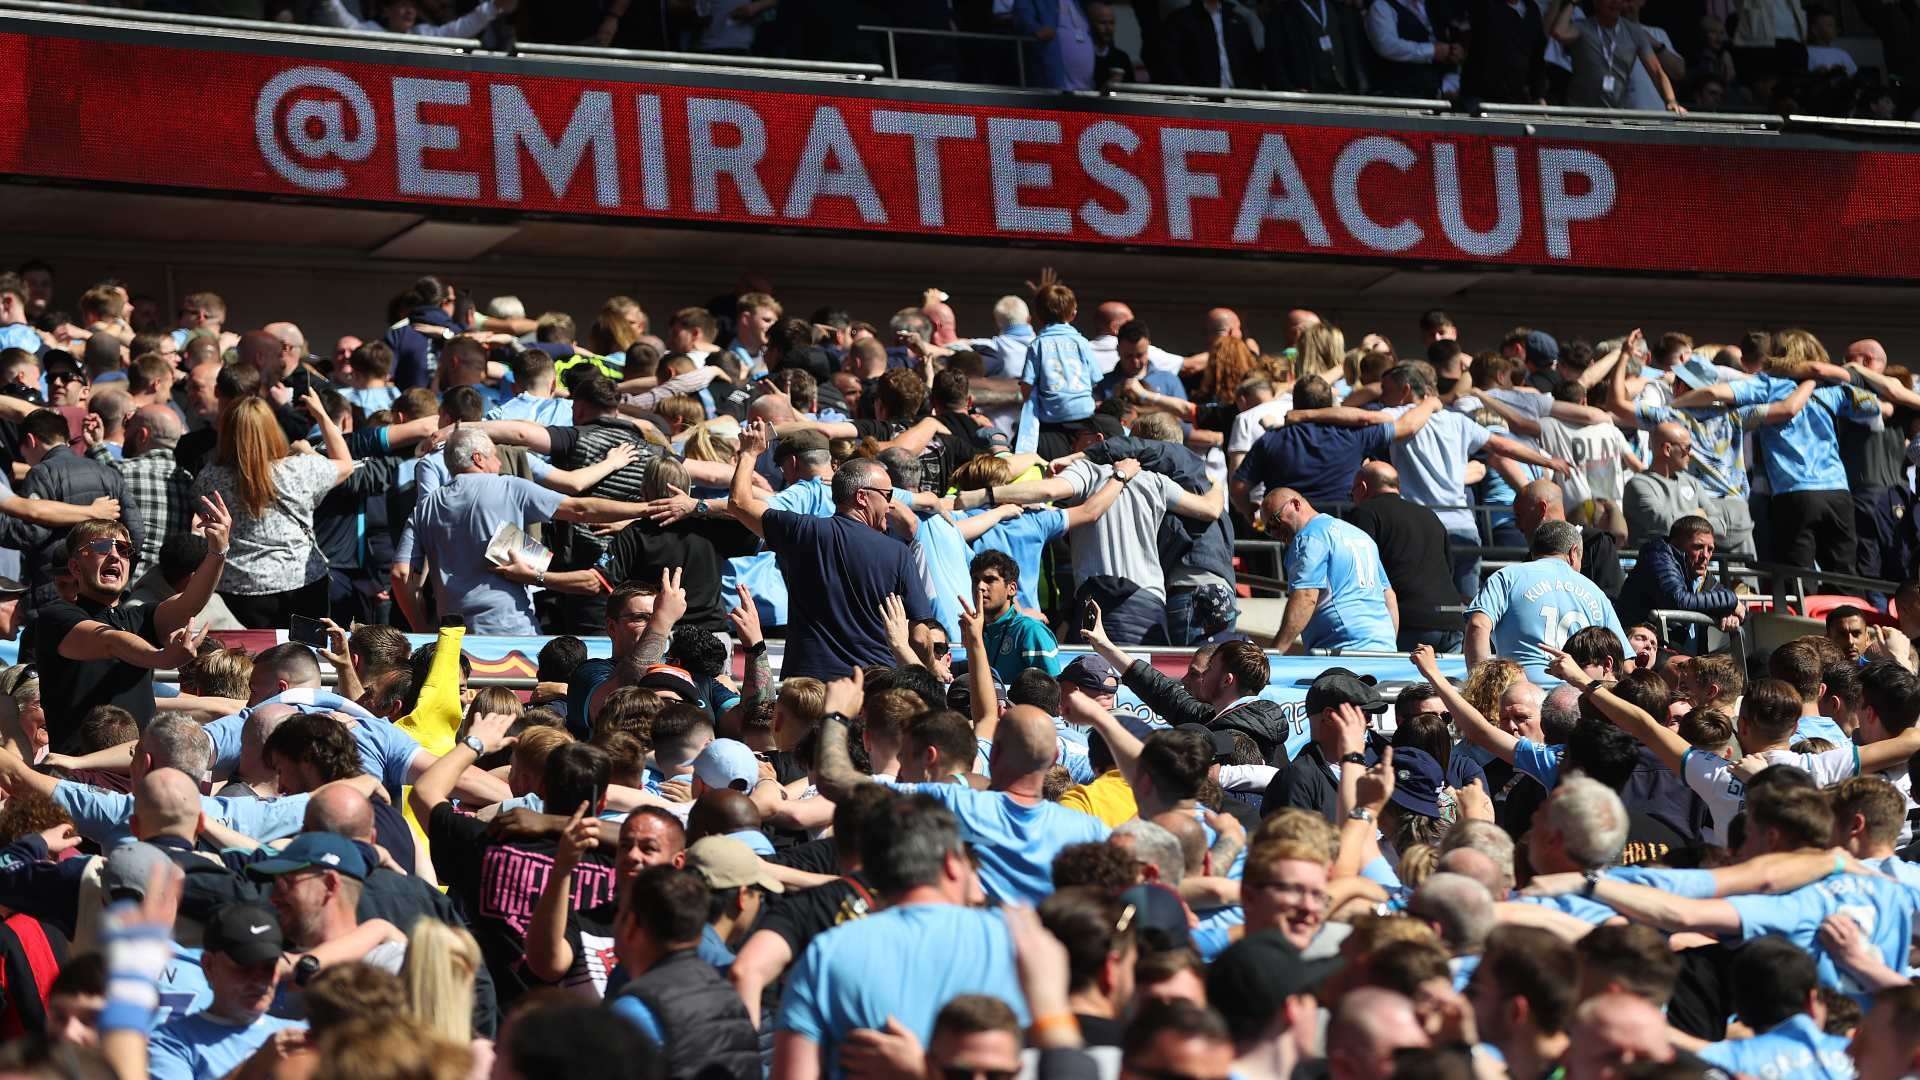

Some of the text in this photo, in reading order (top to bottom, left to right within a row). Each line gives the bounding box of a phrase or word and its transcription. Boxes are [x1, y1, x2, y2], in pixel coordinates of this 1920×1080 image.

[255, 65, 1617, 260] @EMIRATESFACUP
[1343, 537, 1376, 588] 17
[1524, 579, 1554, 603] KUN
